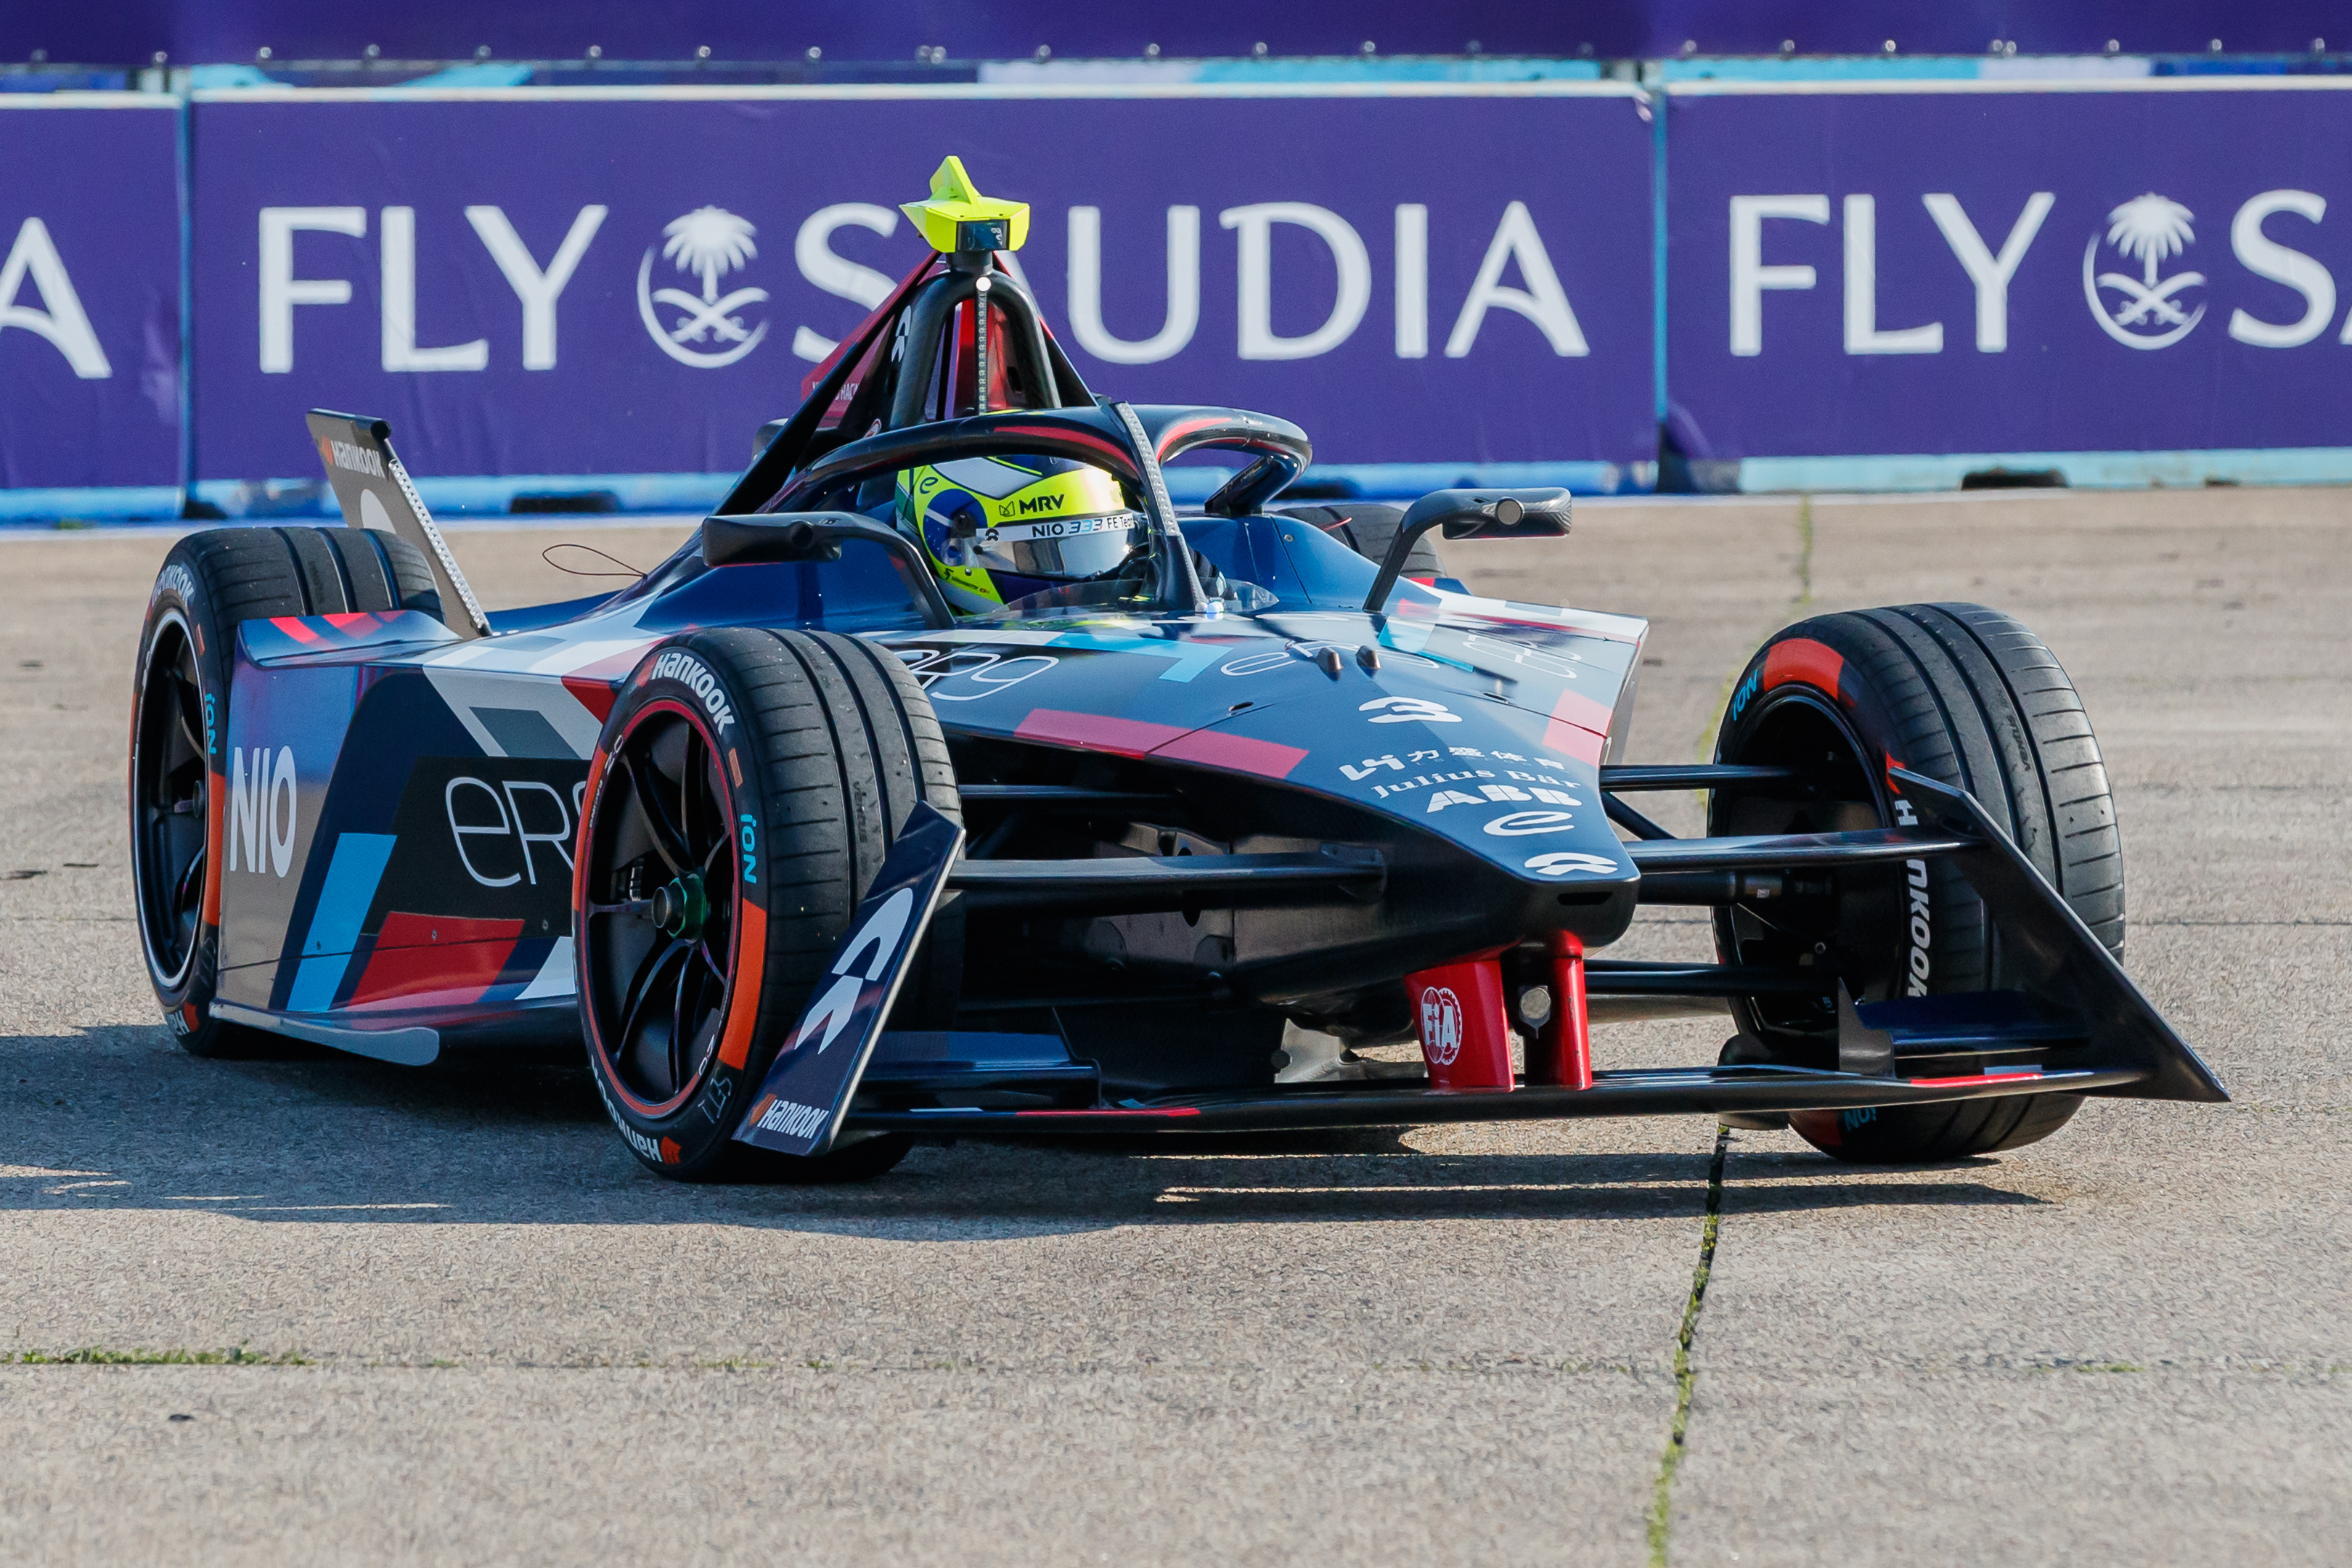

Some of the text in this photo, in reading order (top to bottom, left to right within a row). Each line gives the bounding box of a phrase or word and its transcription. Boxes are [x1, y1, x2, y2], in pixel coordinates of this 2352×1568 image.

[259, 201, 1588, 374] FLY SUDIA
[1729, 189, 2352, 356] FLY S
[1019, 494, 1065, 515] MRV
[1032, 523, 1064, 538] NIO
[1069, 518, 1103, 534] 333
[1107, 516, 1119, 529] FE
[1358, 696, 1463, 724] 3
[1371, 769, 1581, 799] Julius Bär
[1426, 784, 1583, 813] ABB
[229, 745, 296, 878] NIO
[445, 777, 585, 887] eR
